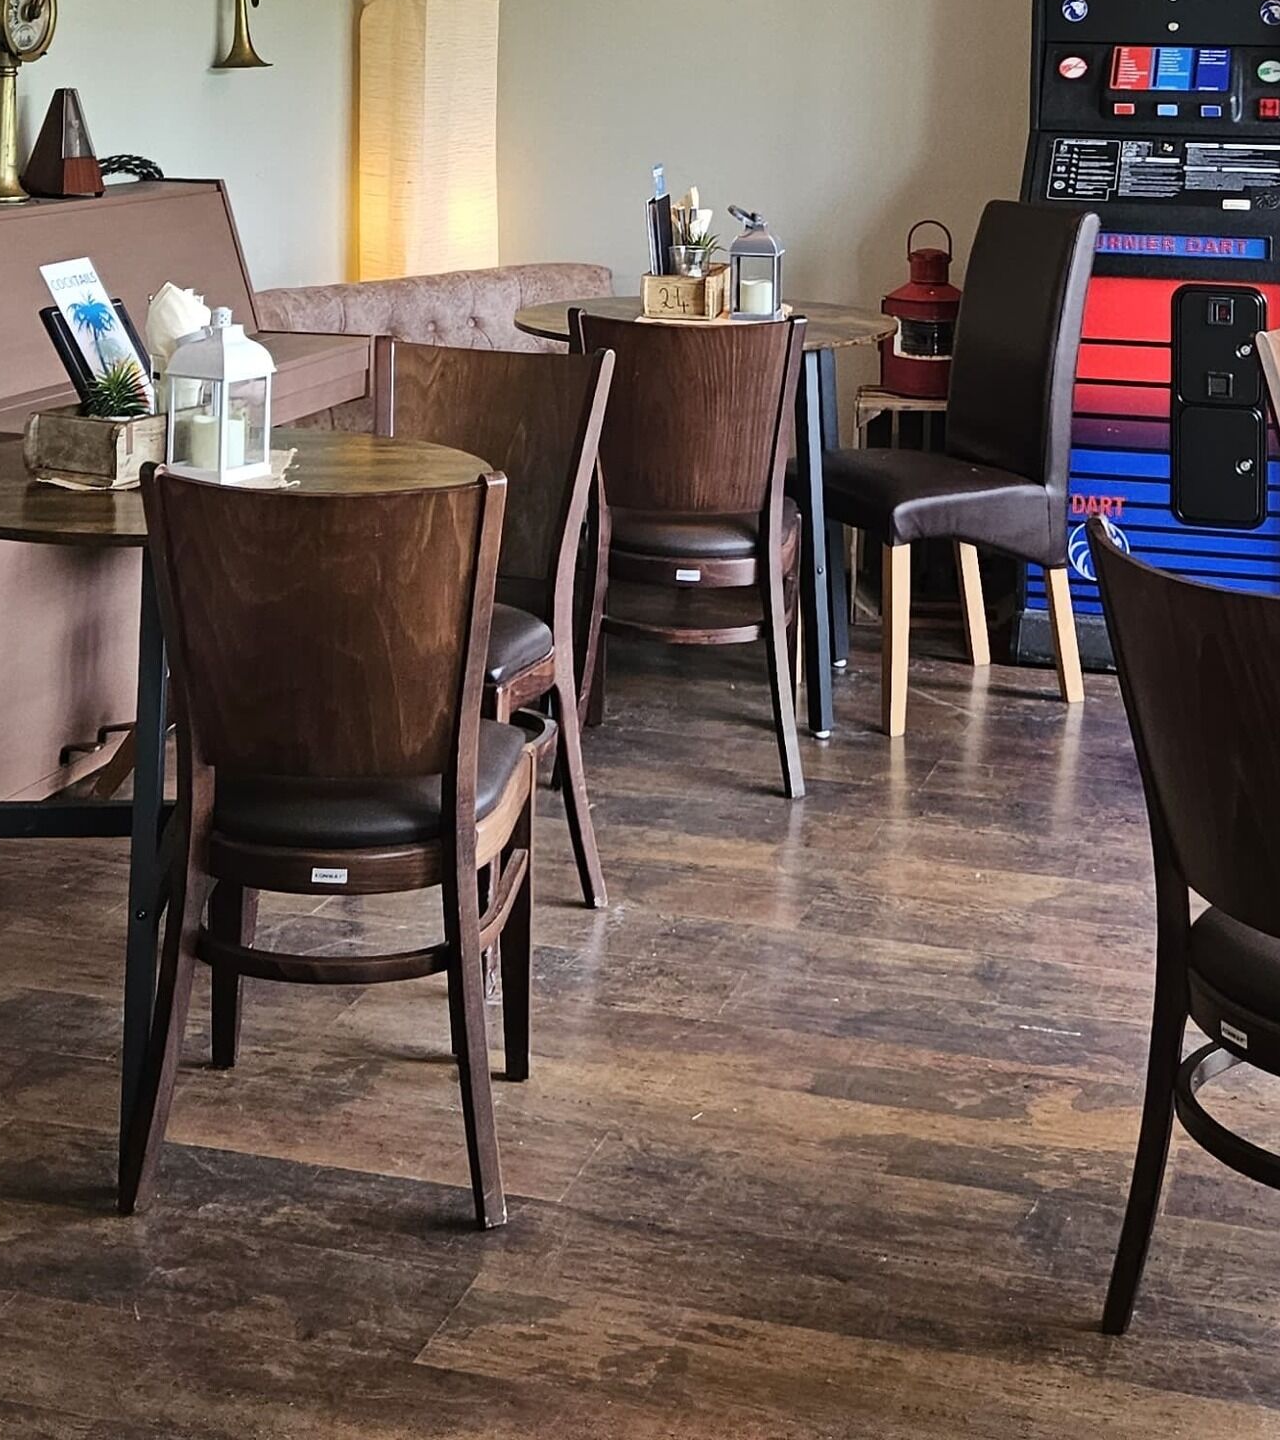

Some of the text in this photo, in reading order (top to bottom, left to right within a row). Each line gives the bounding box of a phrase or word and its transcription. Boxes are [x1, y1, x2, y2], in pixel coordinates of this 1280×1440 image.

[1185, 238, 1249, 254] DART
[659, 287, 690, 313] 24
[1072, 494, 1126, 517] DART
